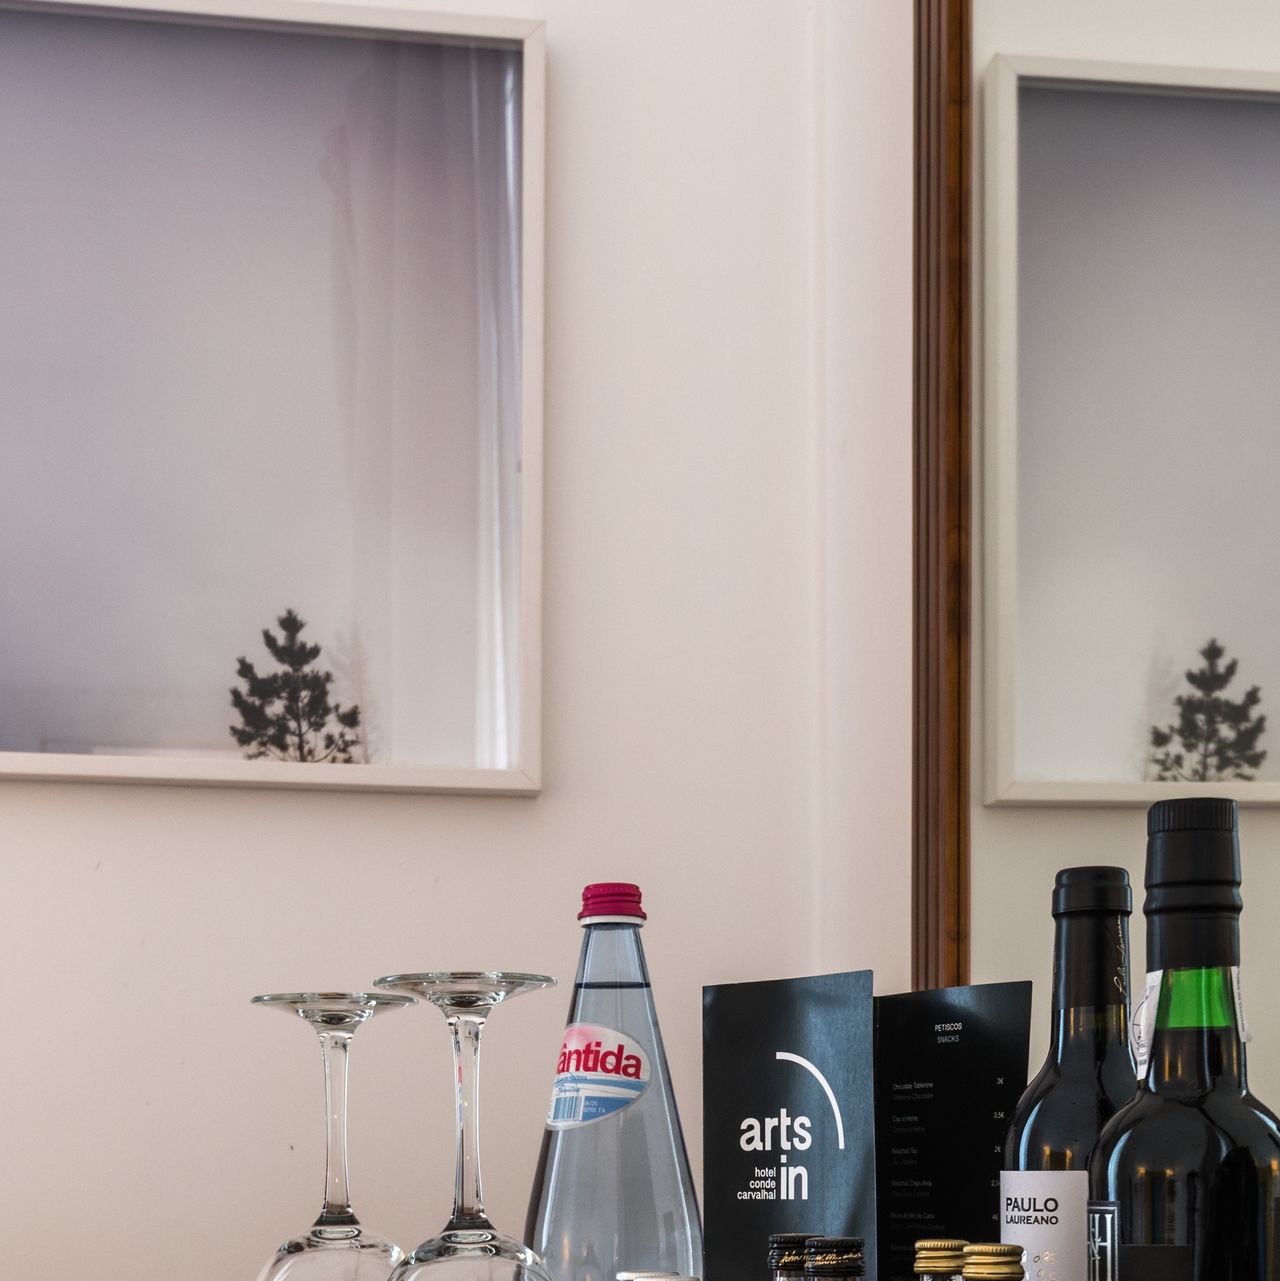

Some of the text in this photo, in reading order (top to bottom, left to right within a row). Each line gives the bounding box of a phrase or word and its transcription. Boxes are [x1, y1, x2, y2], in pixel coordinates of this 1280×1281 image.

[934, 1022, 963, 1032] PETISCOS
[937, 1035, 960, 1044] SNACKS
[740, 1108, 812, 1151] arts
[755, 1167, 776, 1177] hotel
[780, 1154, 808, 1200] in
[749, 1178, 776, 1189] conde
[737, 1190, 776, 1200] carvalhal
[1005, 1197, 1059, 1213] PAULO
[1005, 1215, 1059, 1226] LAUREANO
